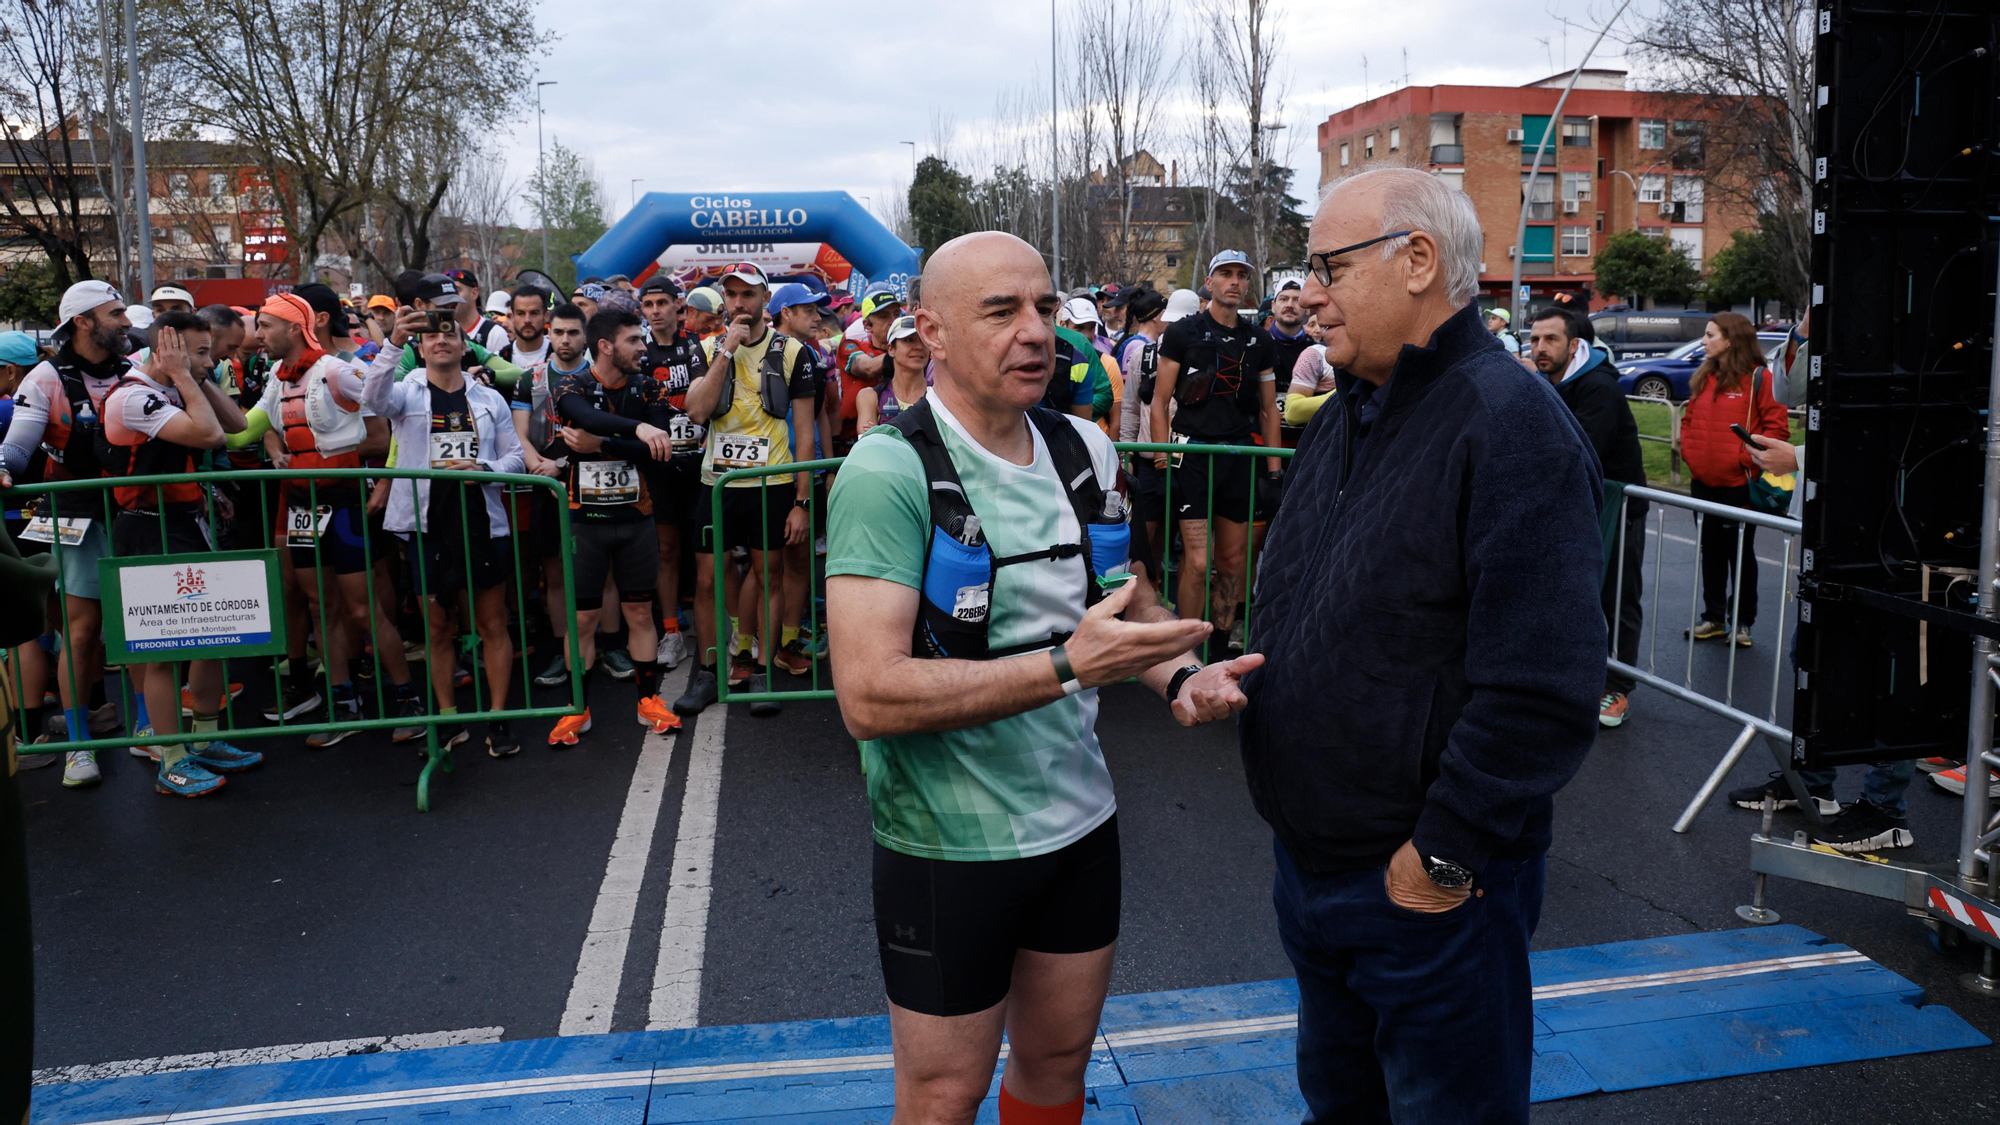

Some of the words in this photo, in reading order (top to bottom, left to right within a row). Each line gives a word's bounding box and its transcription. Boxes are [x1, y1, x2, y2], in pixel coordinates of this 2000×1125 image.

[690, 196, 752, 209] Ciclos
[690, 208, 808, 228] CABELLO
[696, 243, 774, 254] SALIDA
[1627, 316, 1649, 324] GUÍAS
[440, 442, 479, 458] 215
[722, 443, 759, 460] 673
[591, 471, 630, 488] 130
[128, 602, 198, 616] AYUNTAMIENTO
[200, 600, 213, 612] DE
[215, 598, 260, 611] CÓRDOBA
[957, 605, 986, 619] 226ERS
[140, 617, 163, 627] Área
[166, 617, 178, 625] de
[181, 613, 256, 624] Infraestructuras
[160, 628, 187, 637] Equipo
[202, 625, 237, 635] Montajes
[135, 640, 179, 649] PERDONEN
[181, 638, 195, 646] LAS
[198, 636, 241, 645] MOLESTIAS
[168, 773, 187, 786] HOKA
